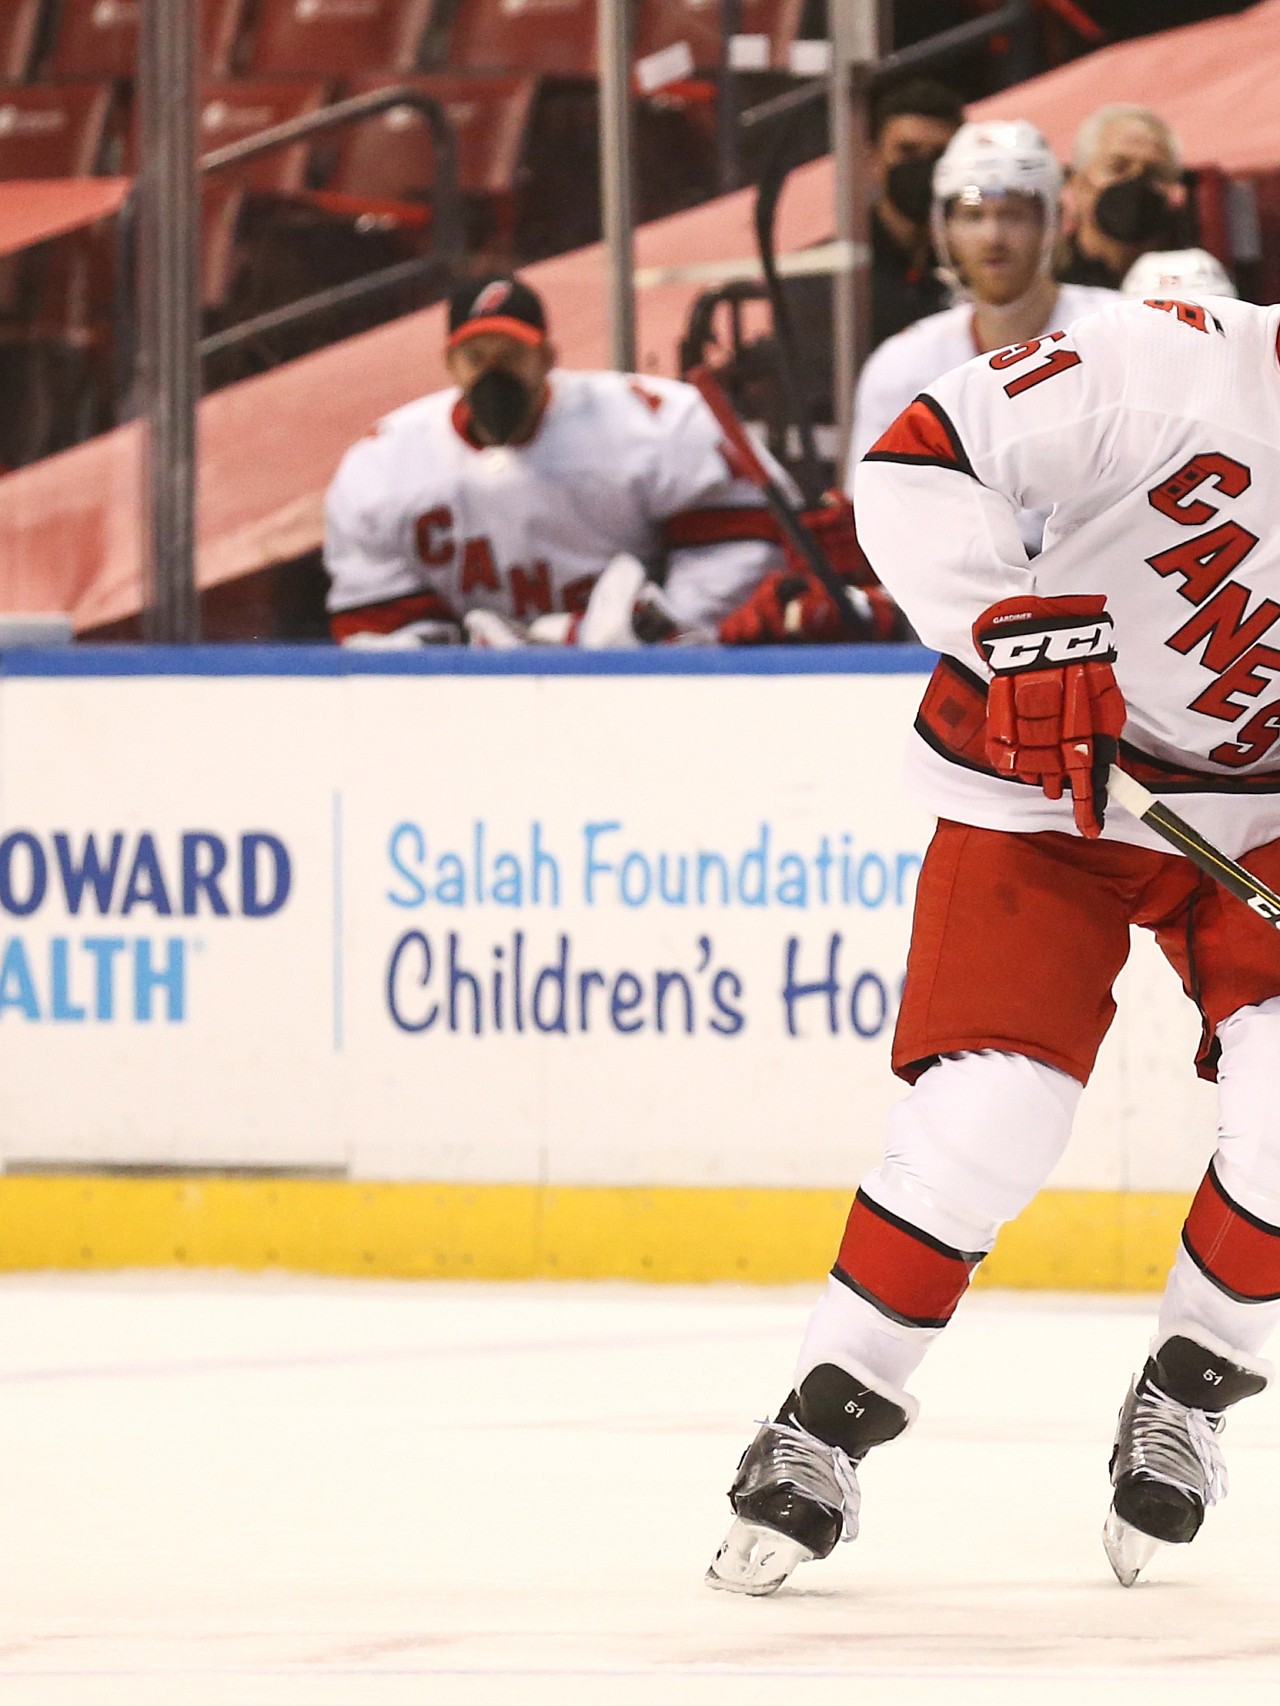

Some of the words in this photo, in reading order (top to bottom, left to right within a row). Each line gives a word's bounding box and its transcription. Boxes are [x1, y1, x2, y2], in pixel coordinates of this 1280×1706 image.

[988, 330, 1083, 400] 51
[992, 612, 1034, 625] GARDINER
[0, 832, 292, 917] OWARD
[387, 822, 560, 909] Salah
[0, 937, 185, 1022] ALTH
[387, 930, 746, 1037] Children's
[783, 931, 907, 1038] Ho
[844, 1400, 866, 1419] 51
[1203, 1368, 1224, 1386] 51
